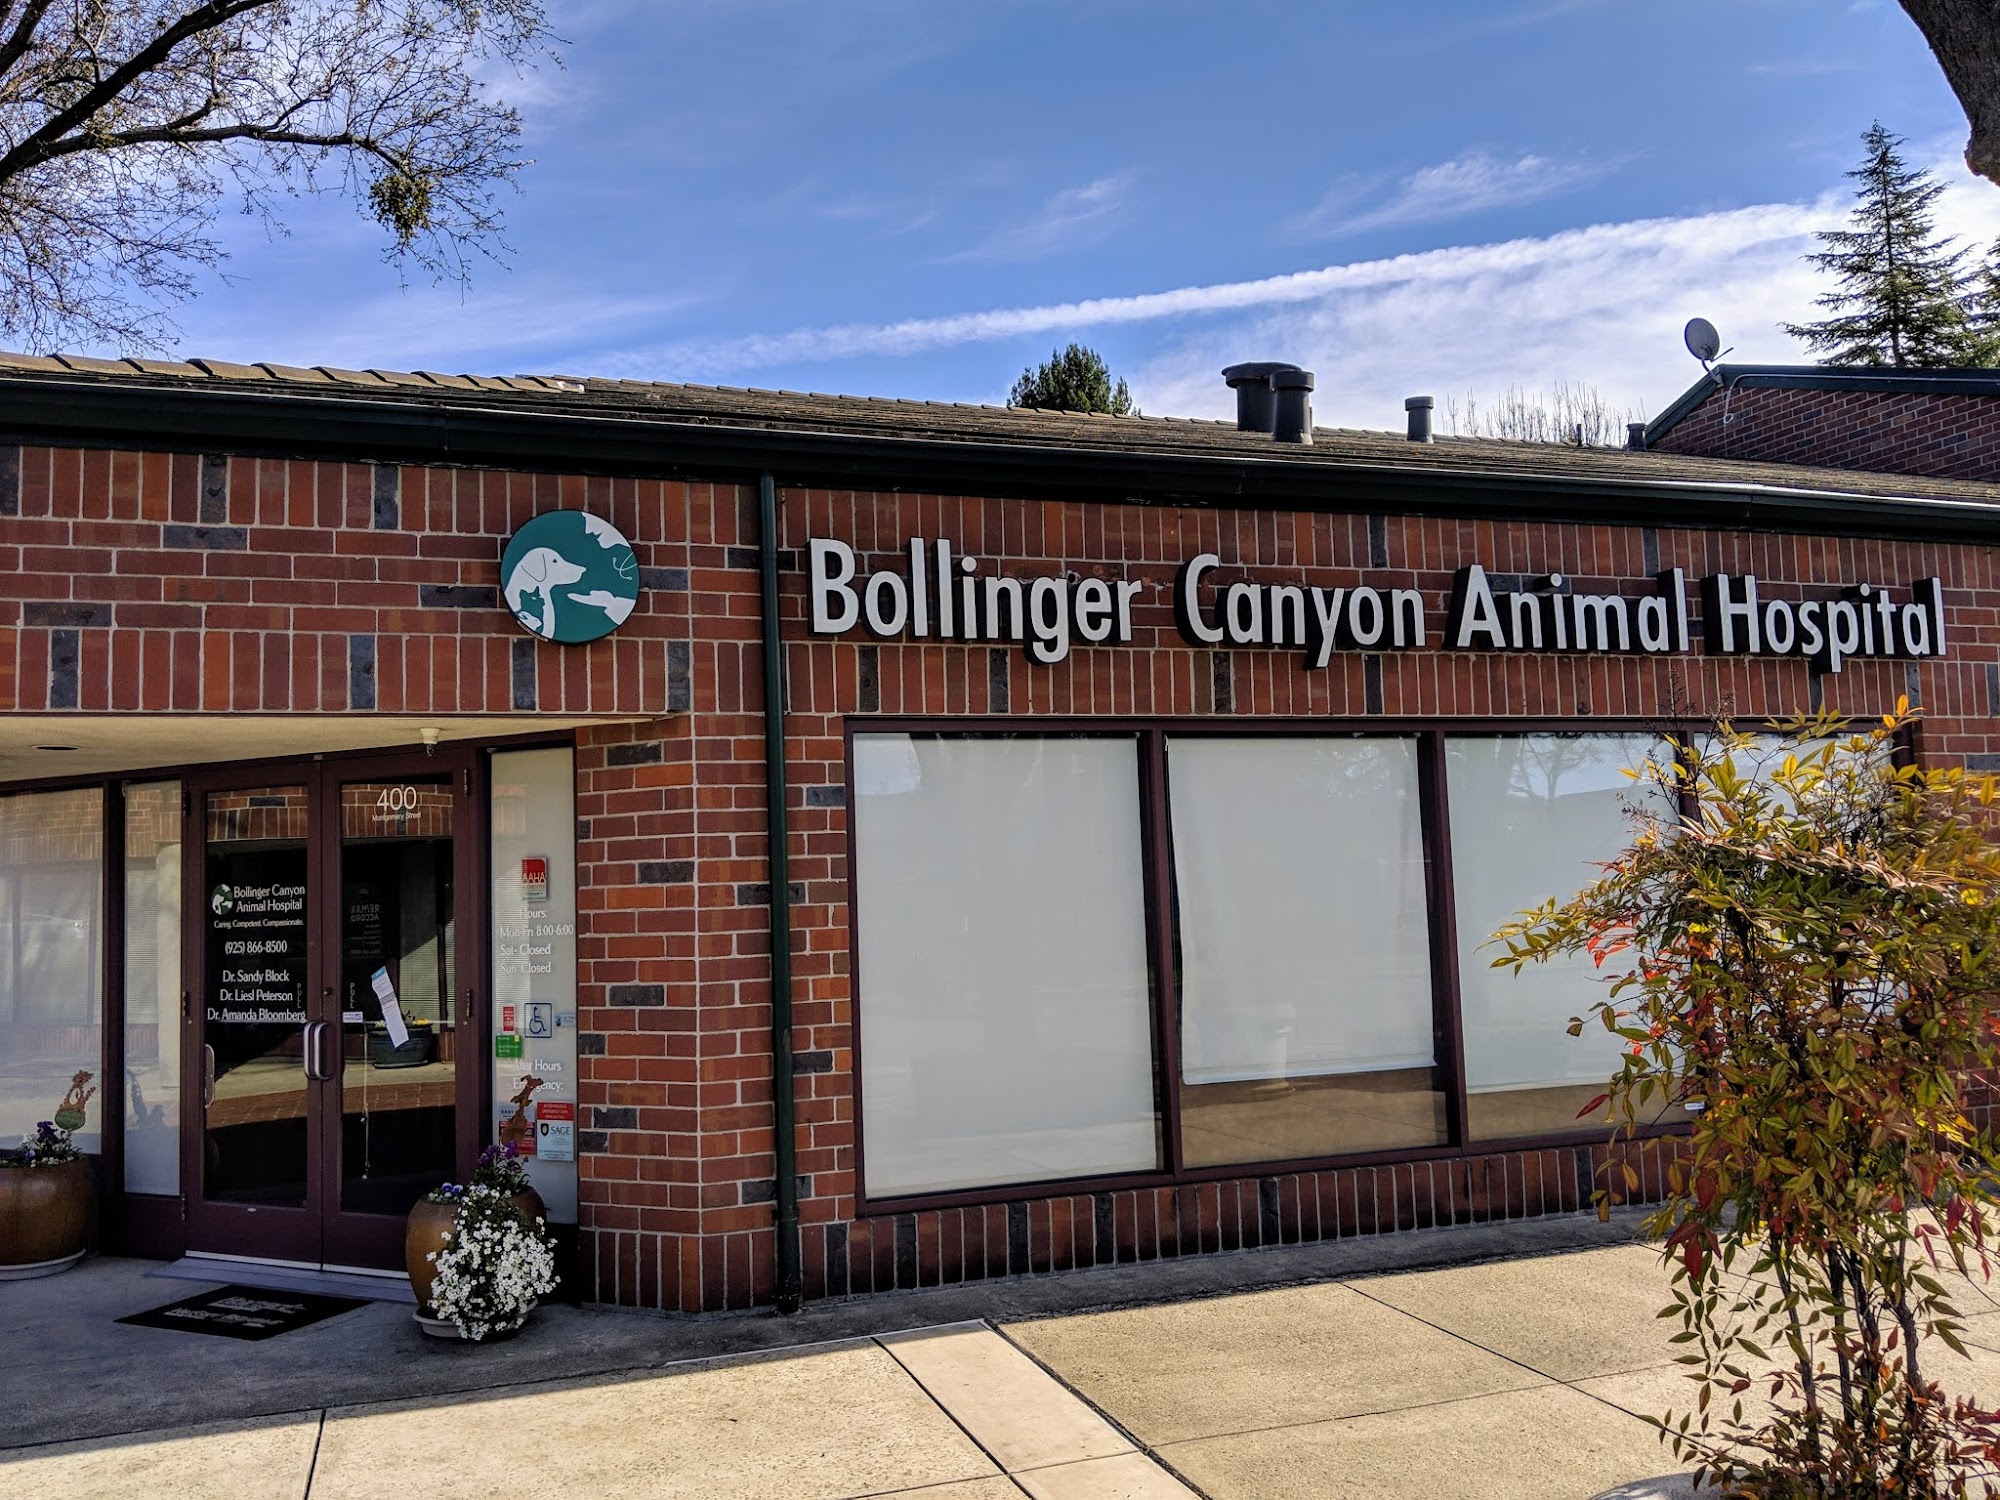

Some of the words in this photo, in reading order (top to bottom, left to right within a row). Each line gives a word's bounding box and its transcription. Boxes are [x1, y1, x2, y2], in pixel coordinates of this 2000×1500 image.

[810, 537, 1142, 664] Bollinger
[1185, 554, 1425, 668] Canyon
[1456, 564, 1689, 652] Animal
[1718, 573, 1946, 673] Hospital
[376, 786, 417, 811] 400
[371, 813, 405, 822] Montgomery
[405, 811, 422, 819] Street
[522, 872, 546, 883] AAHA
[233, 886, 271, 900] Bollinger
[271, 884, 305, 897] Canyon
[236, 900, 266, 912] Animal
[267, 898, 303, 912] Hospital
[520, 908, 548, 918] Hours:
[536, 924, 574, 936] 8:00-6:00
[225, 941, 245, 955] (925)
[246, 940, 288, 953] 866-8500
[519, 943, 551, 955] Closed
[520, 962, 552, 973] Closed
[222, 970, 236, 982] Dr.
[236, 969, 264, 985] Sandy
[265, 969, 290, 982] Block
[220, 988, 234, 1001] Dr.
[234, 989, 255, 1001] Liesl
[256, 989, 293, 1001] Peterson
[207, 1007, 221, 1020] Dr.
[221, 1008, 258, 1021] Amanda
[258, 1008, 308, 1024] Bloomberg
[534, 1059, 562, 1071] Hours
[550, 1126, 571, 1136] SAGE
